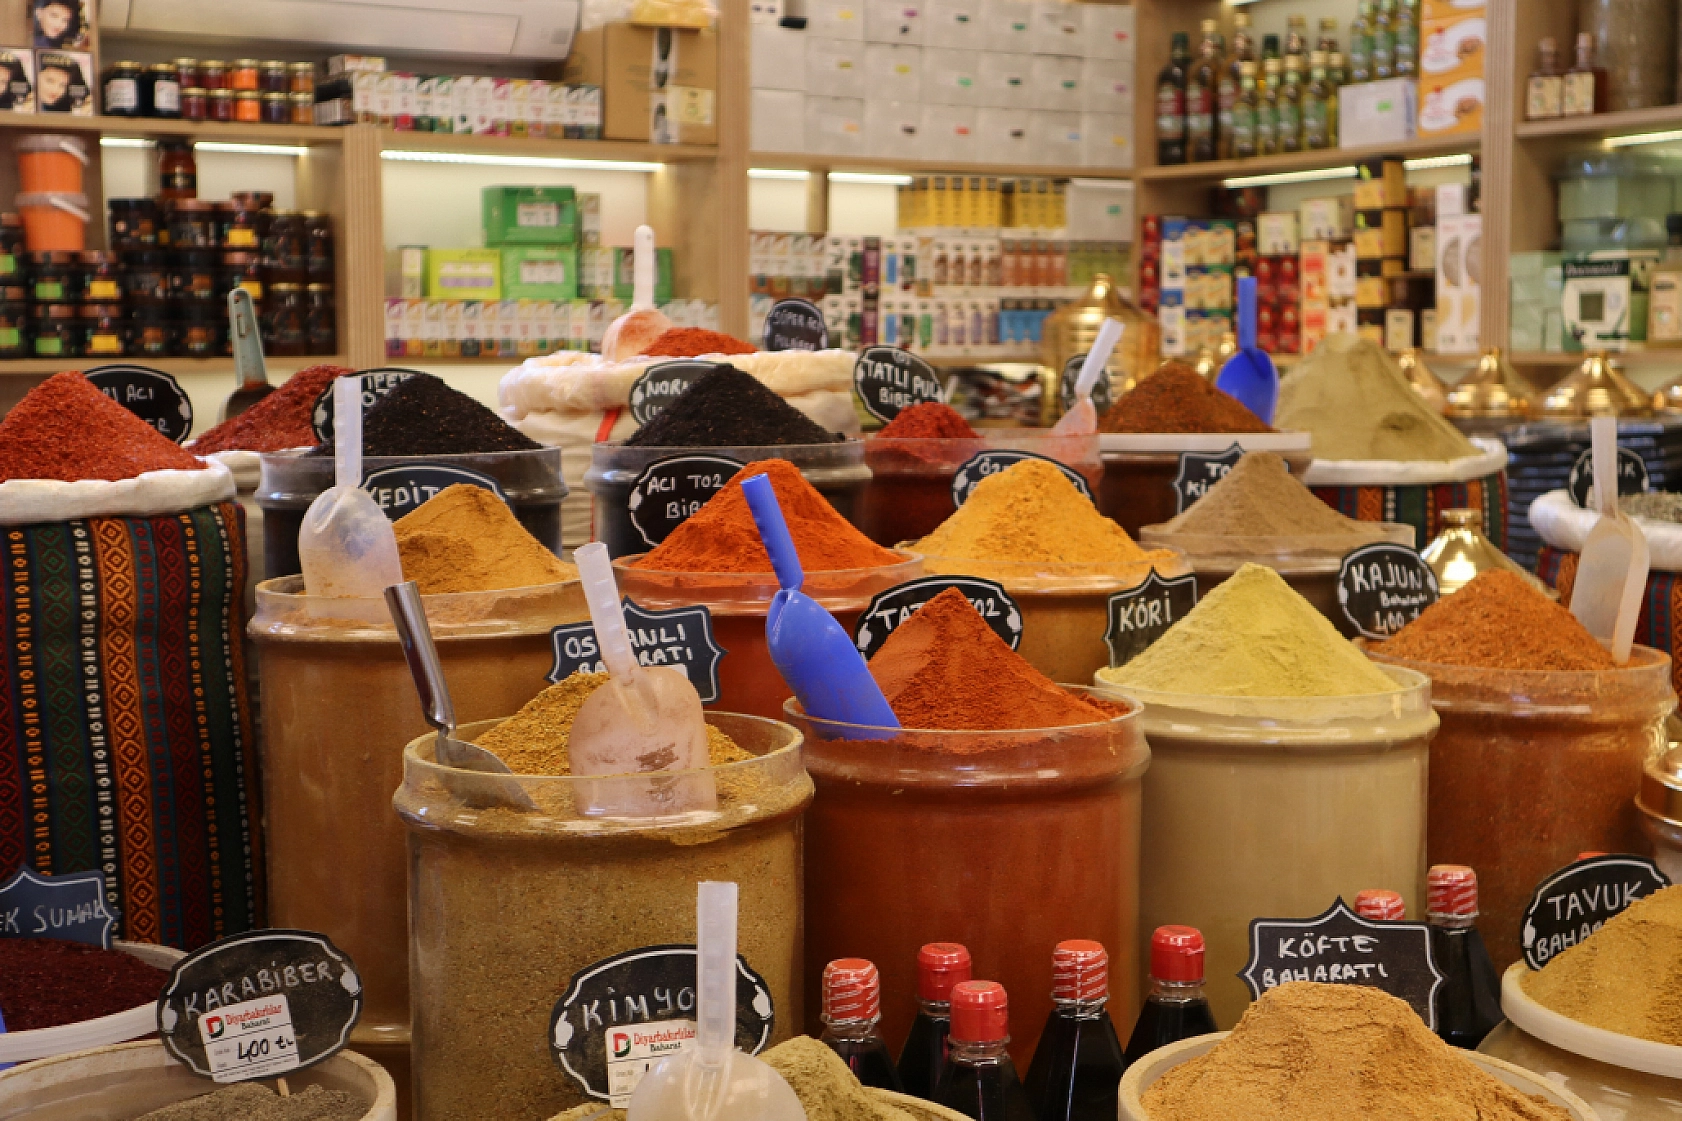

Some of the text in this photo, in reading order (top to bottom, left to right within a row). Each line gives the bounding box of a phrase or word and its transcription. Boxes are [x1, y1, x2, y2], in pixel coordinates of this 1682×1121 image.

[862, 360, 911, 389] TATLI
[126, 384, 154, 402] ACI
[878, 387, 920, 408] BİBE
[646, 476, 676, 496] ACI
[1350, 554, 1423, 594] KAJUN
[1120, 590, 1172, 633] KÖRİ
[564, 623, 687, 659] OSANLI
[578, 646, 693, 674] BARATI
[1547, 880, 1642, 921] TAVUK
[1278, 931, 1381, 959] KÖFTE
[1262, 962, 1389, 989] BAHARATI
[184, 960, 333, 1021] KARABİBER
[237, 1038, 270, 1062] 400
